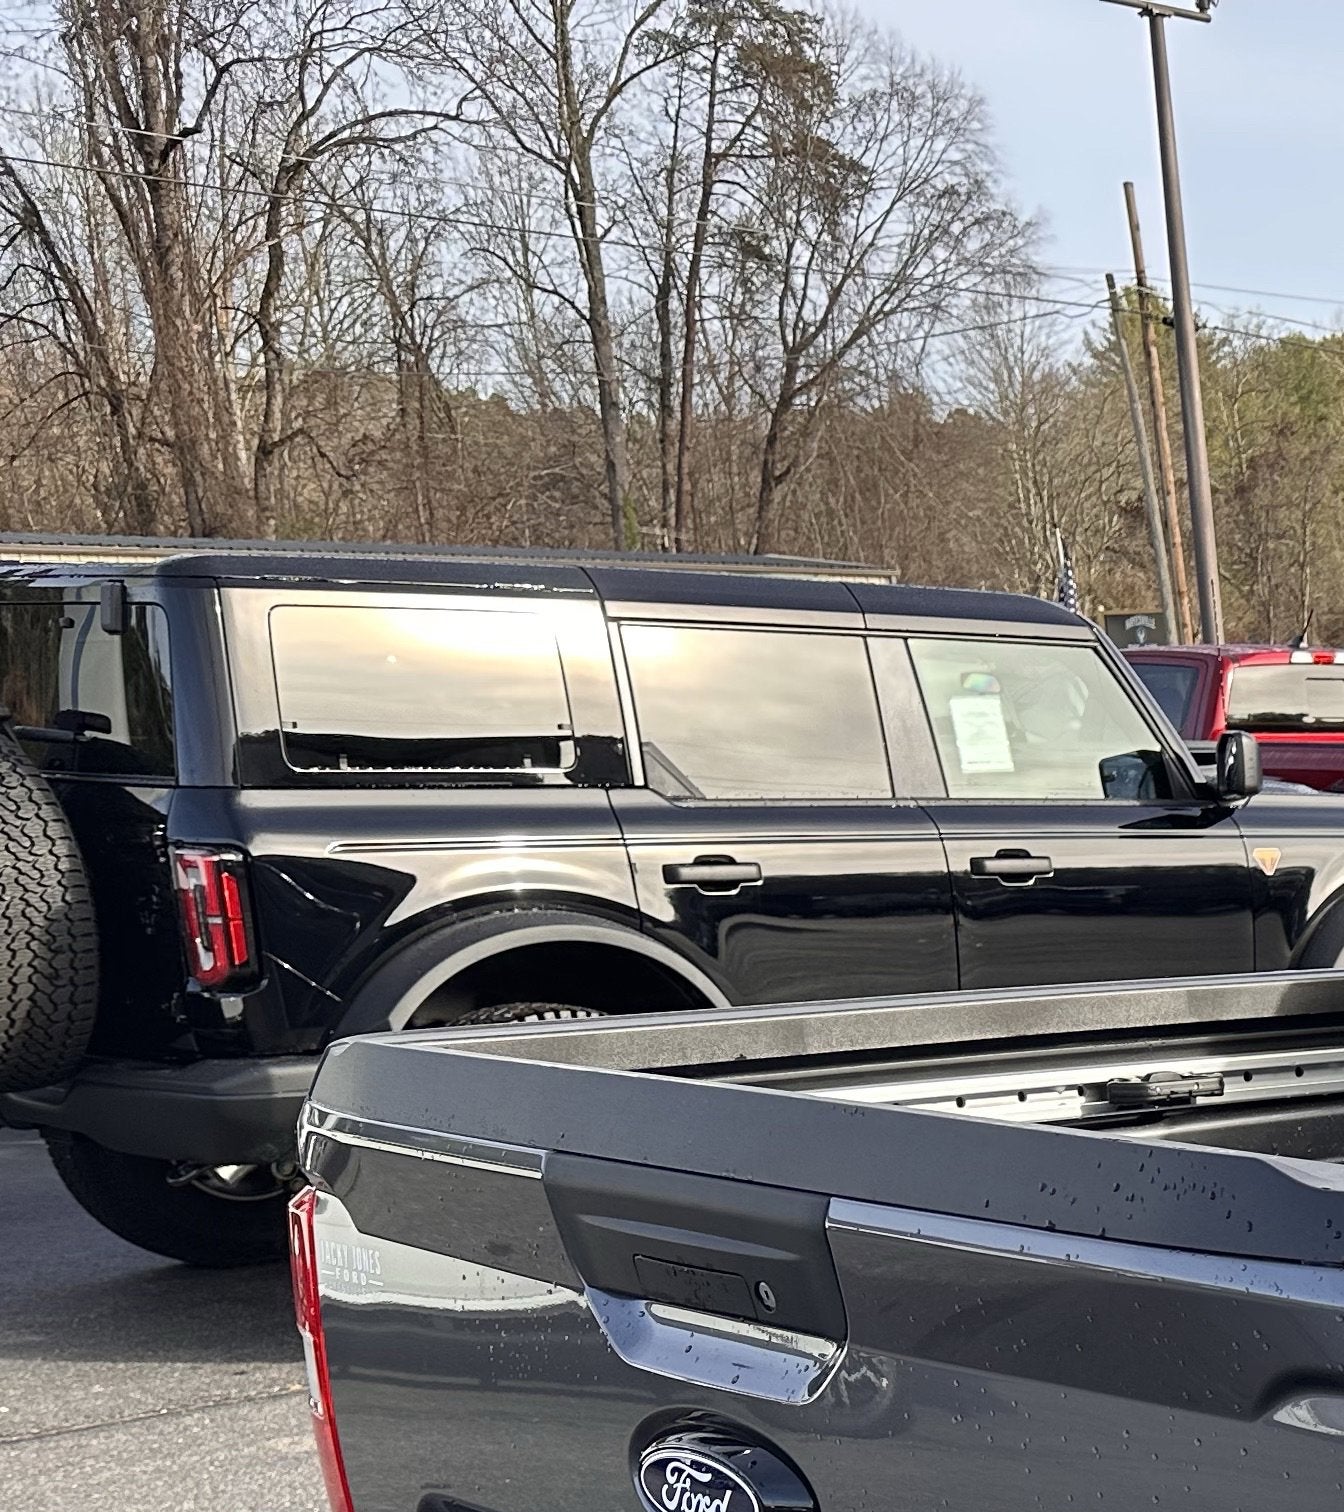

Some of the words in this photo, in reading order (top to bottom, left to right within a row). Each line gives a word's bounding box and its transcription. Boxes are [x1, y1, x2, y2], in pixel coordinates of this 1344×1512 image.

[319, 1239, 349, 1269] JACKY
[351, 1245, 382, 1276] JONES
[335, 1267, 368, 1287] FORD
